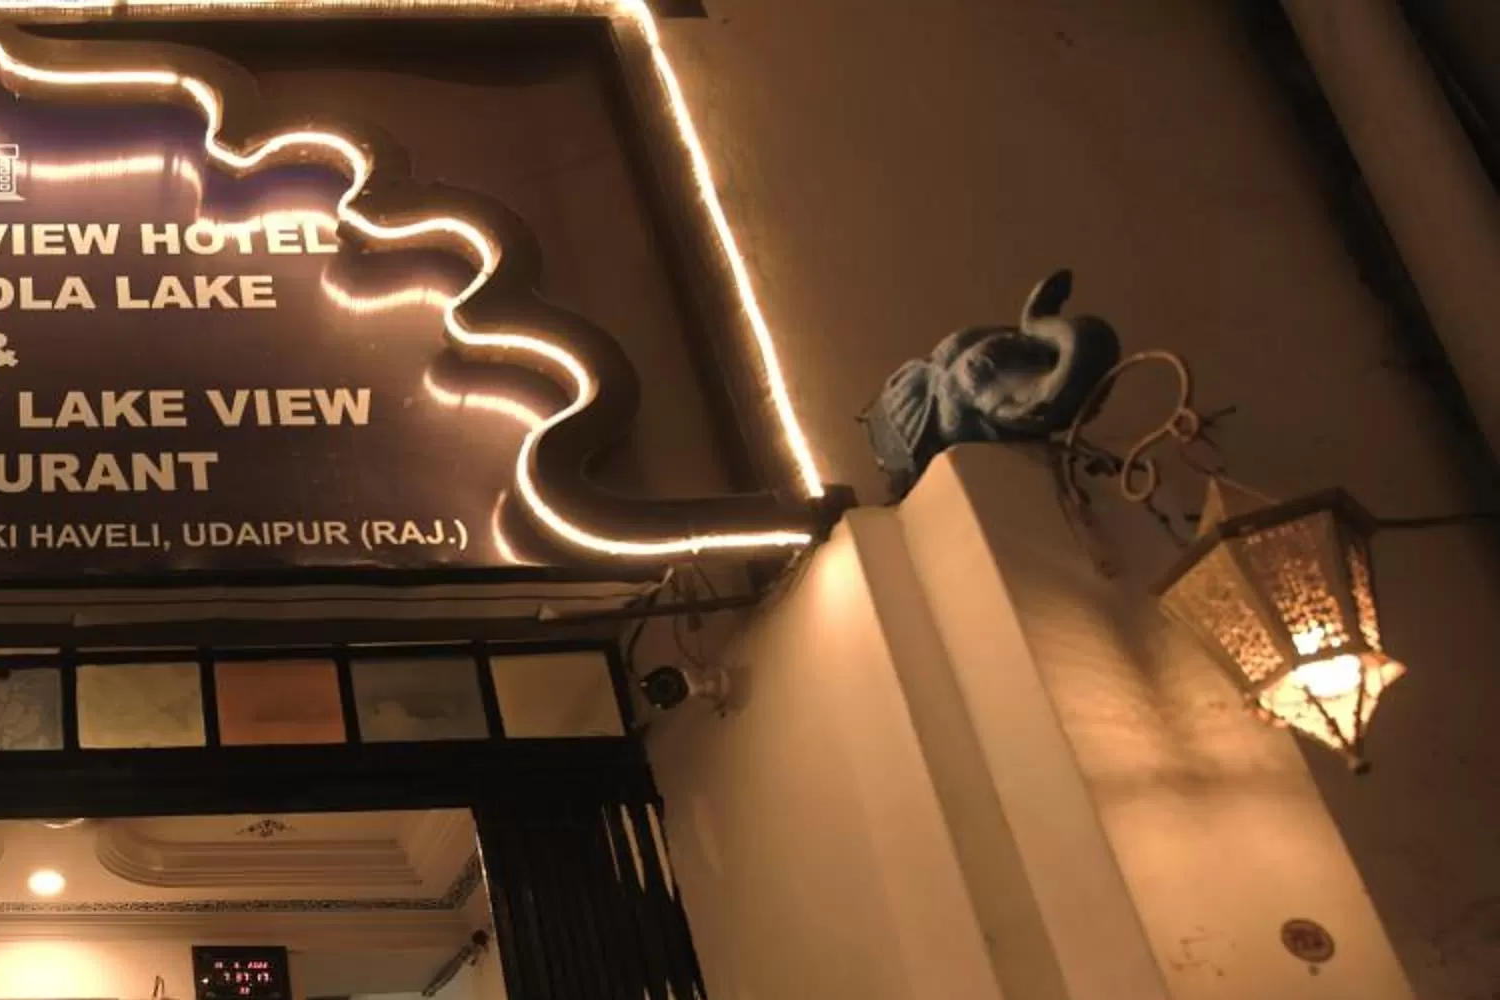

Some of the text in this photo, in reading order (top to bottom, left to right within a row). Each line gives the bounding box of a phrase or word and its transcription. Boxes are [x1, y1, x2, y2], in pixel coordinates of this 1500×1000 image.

[140, 222, 339, 255] HOTEL
[115, 274, 277, 310] LAKE
[18, 390, 188, 428] LAKE
[205, 388, 371, 427] VIEW
[30, 522, 171, 551] HAVELI,
[182, 520, 350, 548] UDAIPUR
[360, 518, 468, 550] (RAJ.)
